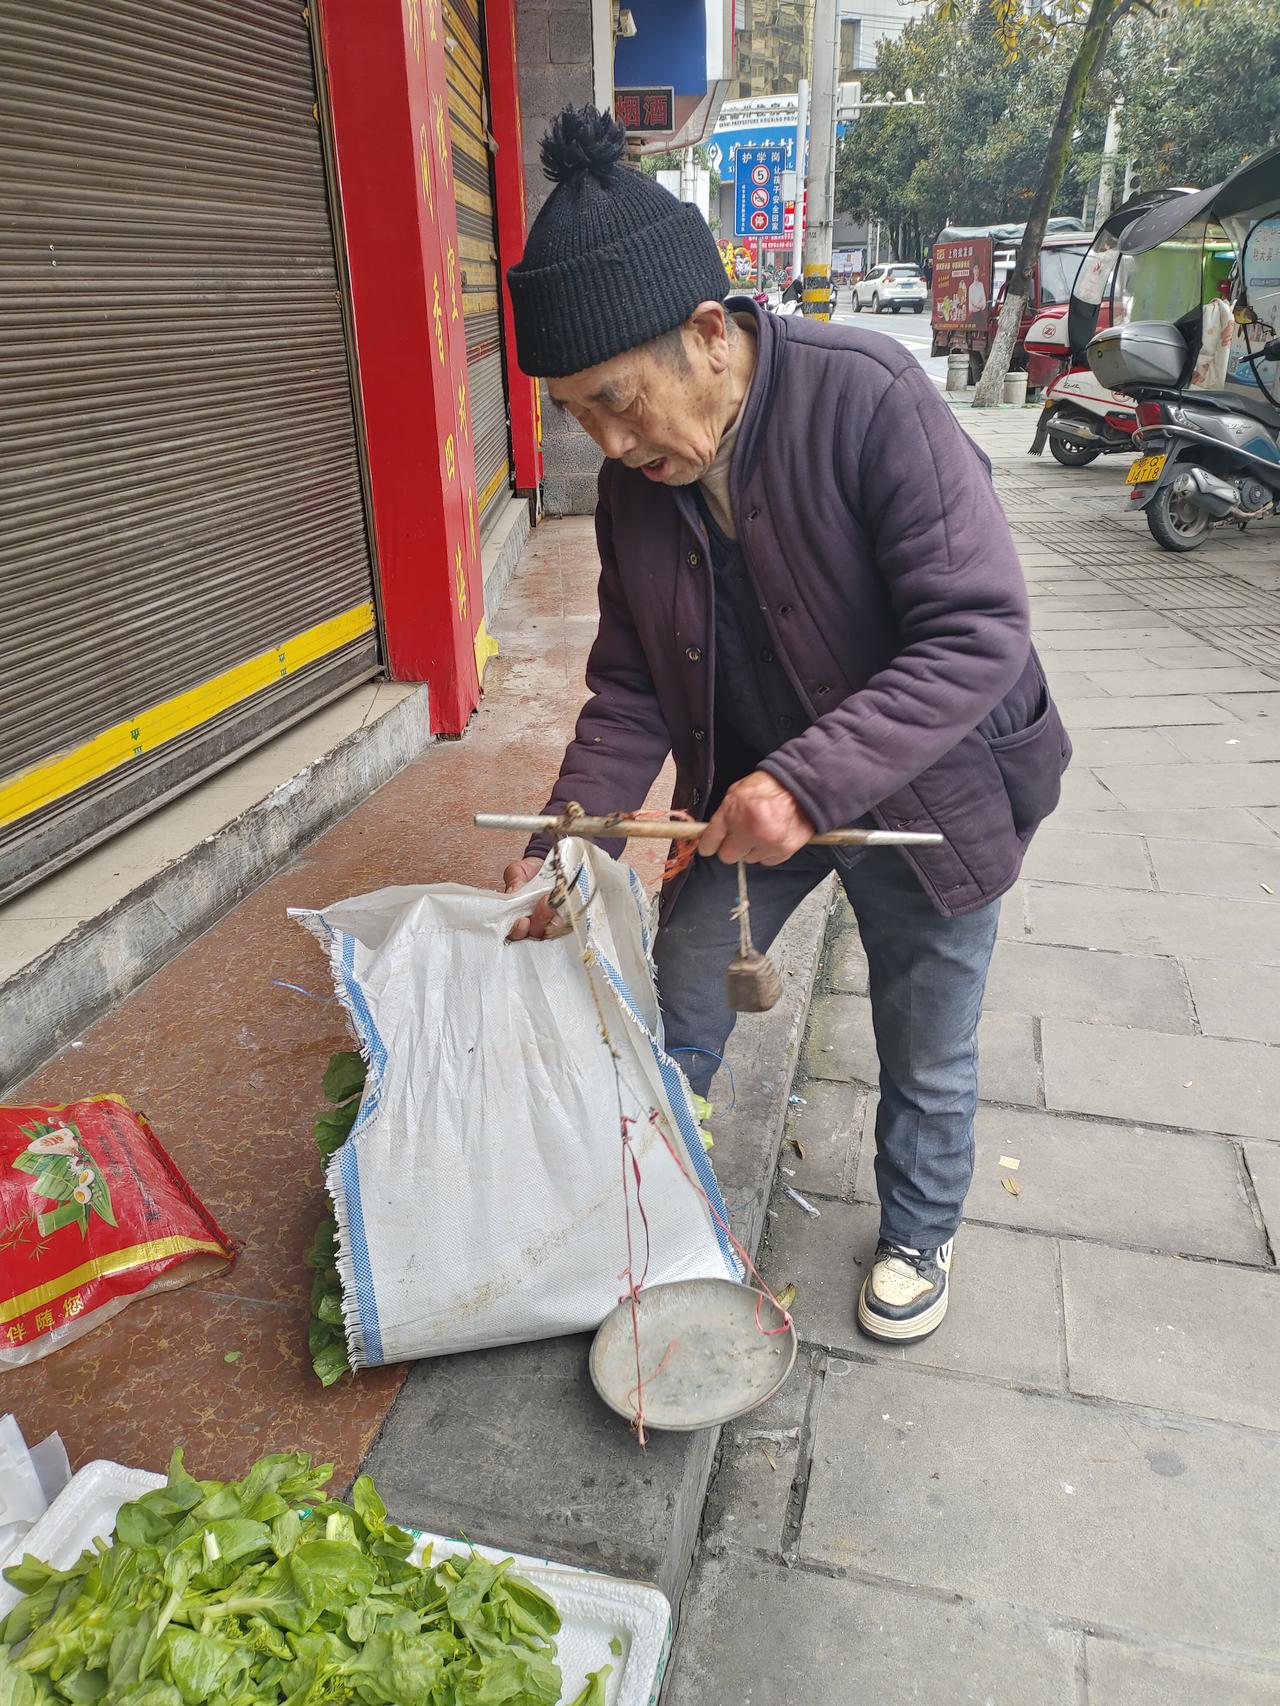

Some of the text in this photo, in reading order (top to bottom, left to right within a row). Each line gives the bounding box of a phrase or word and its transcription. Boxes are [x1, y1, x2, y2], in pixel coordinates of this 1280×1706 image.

[615, 95, 667, 126] 烟酒
[742, 151, 780, 164] 护学岗
[757, 170, 764, 181] 5
[771, 165, 780, 231] 让孩子安全回家
[755, 215, 766, 227] 停
